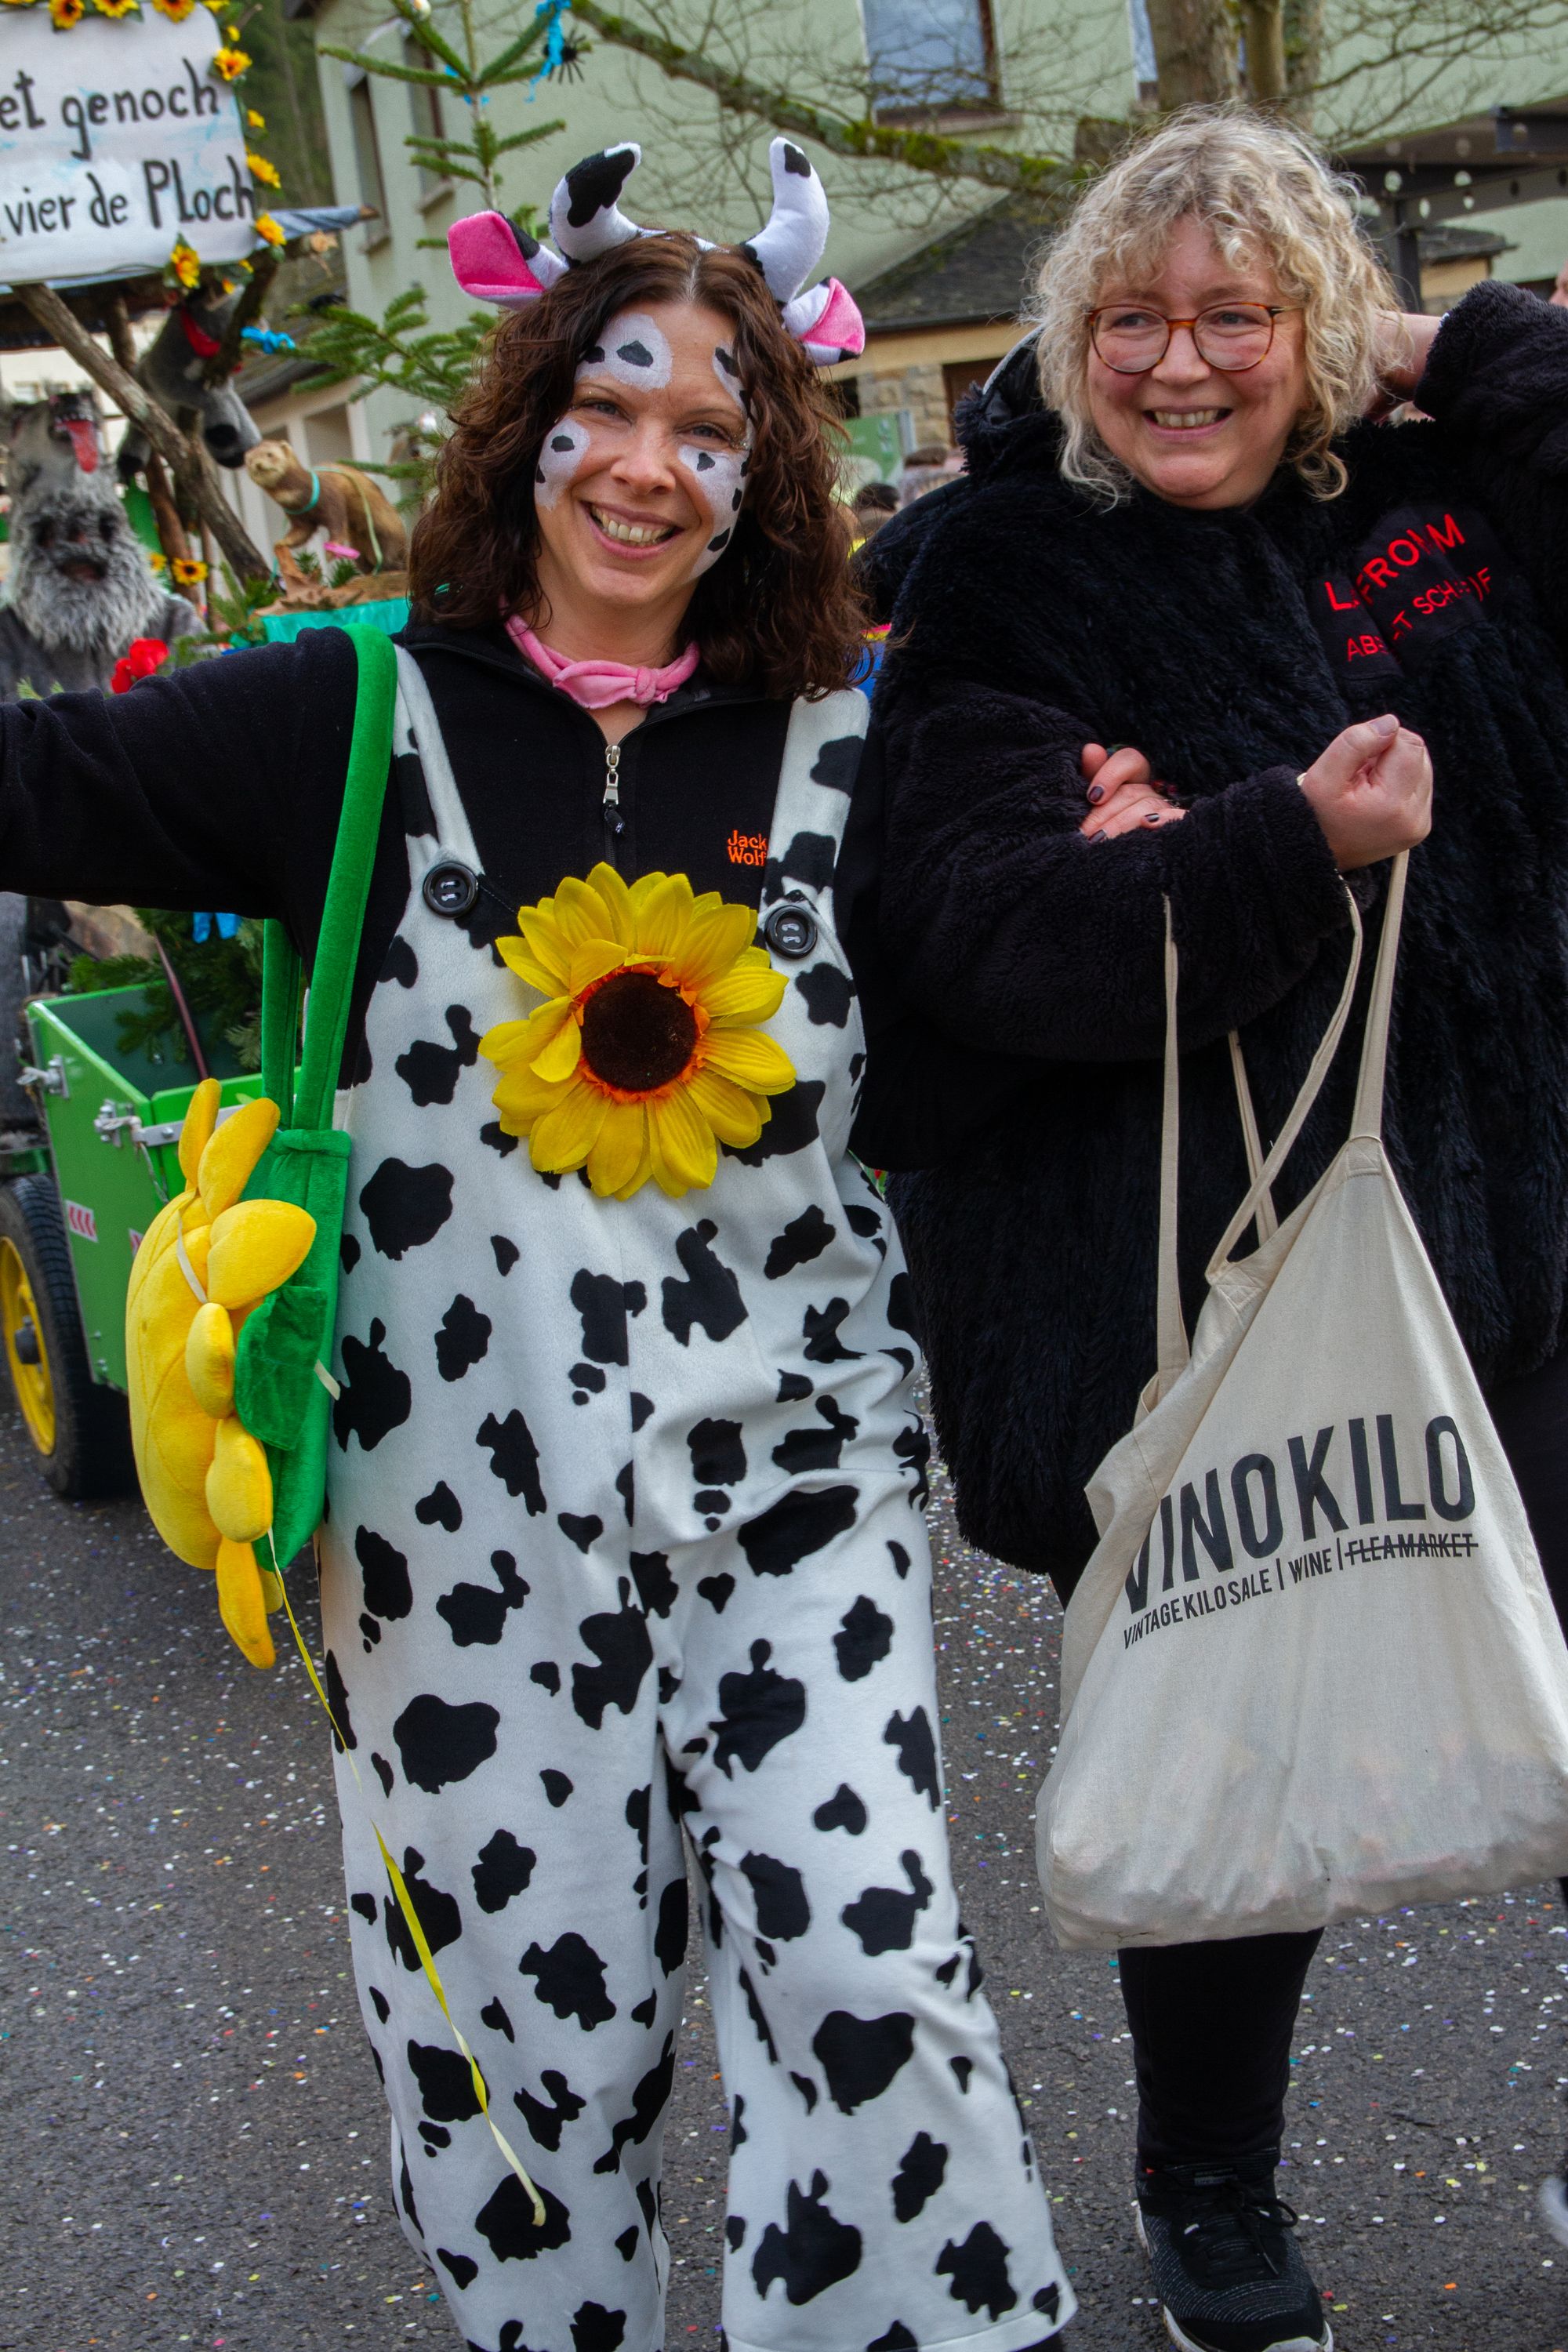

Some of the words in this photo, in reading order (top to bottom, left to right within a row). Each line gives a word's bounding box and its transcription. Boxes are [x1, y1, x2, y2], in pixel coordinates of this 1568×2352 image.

[61, 56, 220, 162] genoch
[5, 187, 76, 236] vier
[86, 171, 129, 228] de
[727, 829, 768, 850] Jack
[728, 846, 767, 866] Wolf
[1123, 1598, 1184, 1650] VINTAGE
[1182, 1585, 1227, 1620] KILO
[1228, 1568, 1273, 1606] SALE
[1288, 1548, 1333, 1584] WINE
[1346, 1534, 1396, 1566] FLEA
[1398, 1533, 1476, 1558] MARKET
